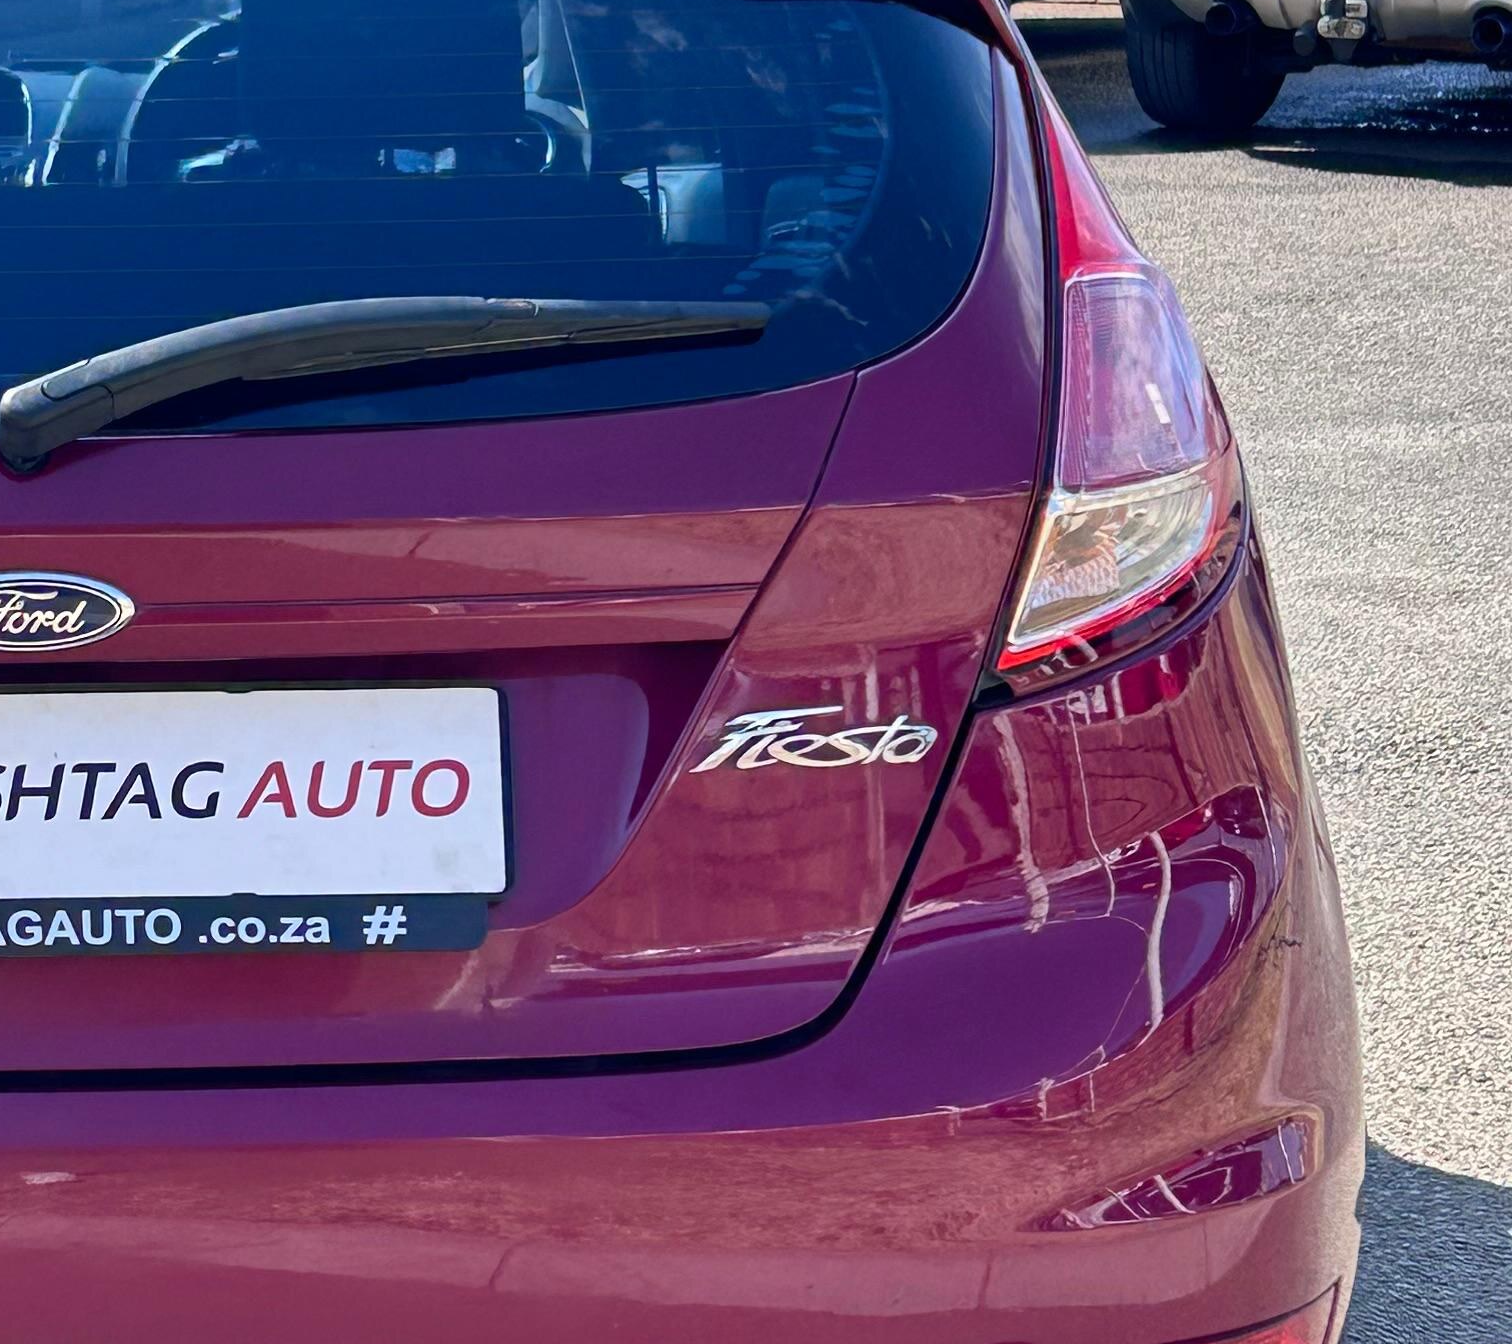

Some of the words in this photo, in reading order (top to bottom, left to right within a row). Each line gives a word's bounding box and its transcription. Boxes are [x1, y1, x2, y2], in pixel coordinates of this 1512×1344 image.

[688, 705, 939, 773] Fiesta
[236, 758, 471, 820] AUTO
[197, 912, 332, 945] .co.za
